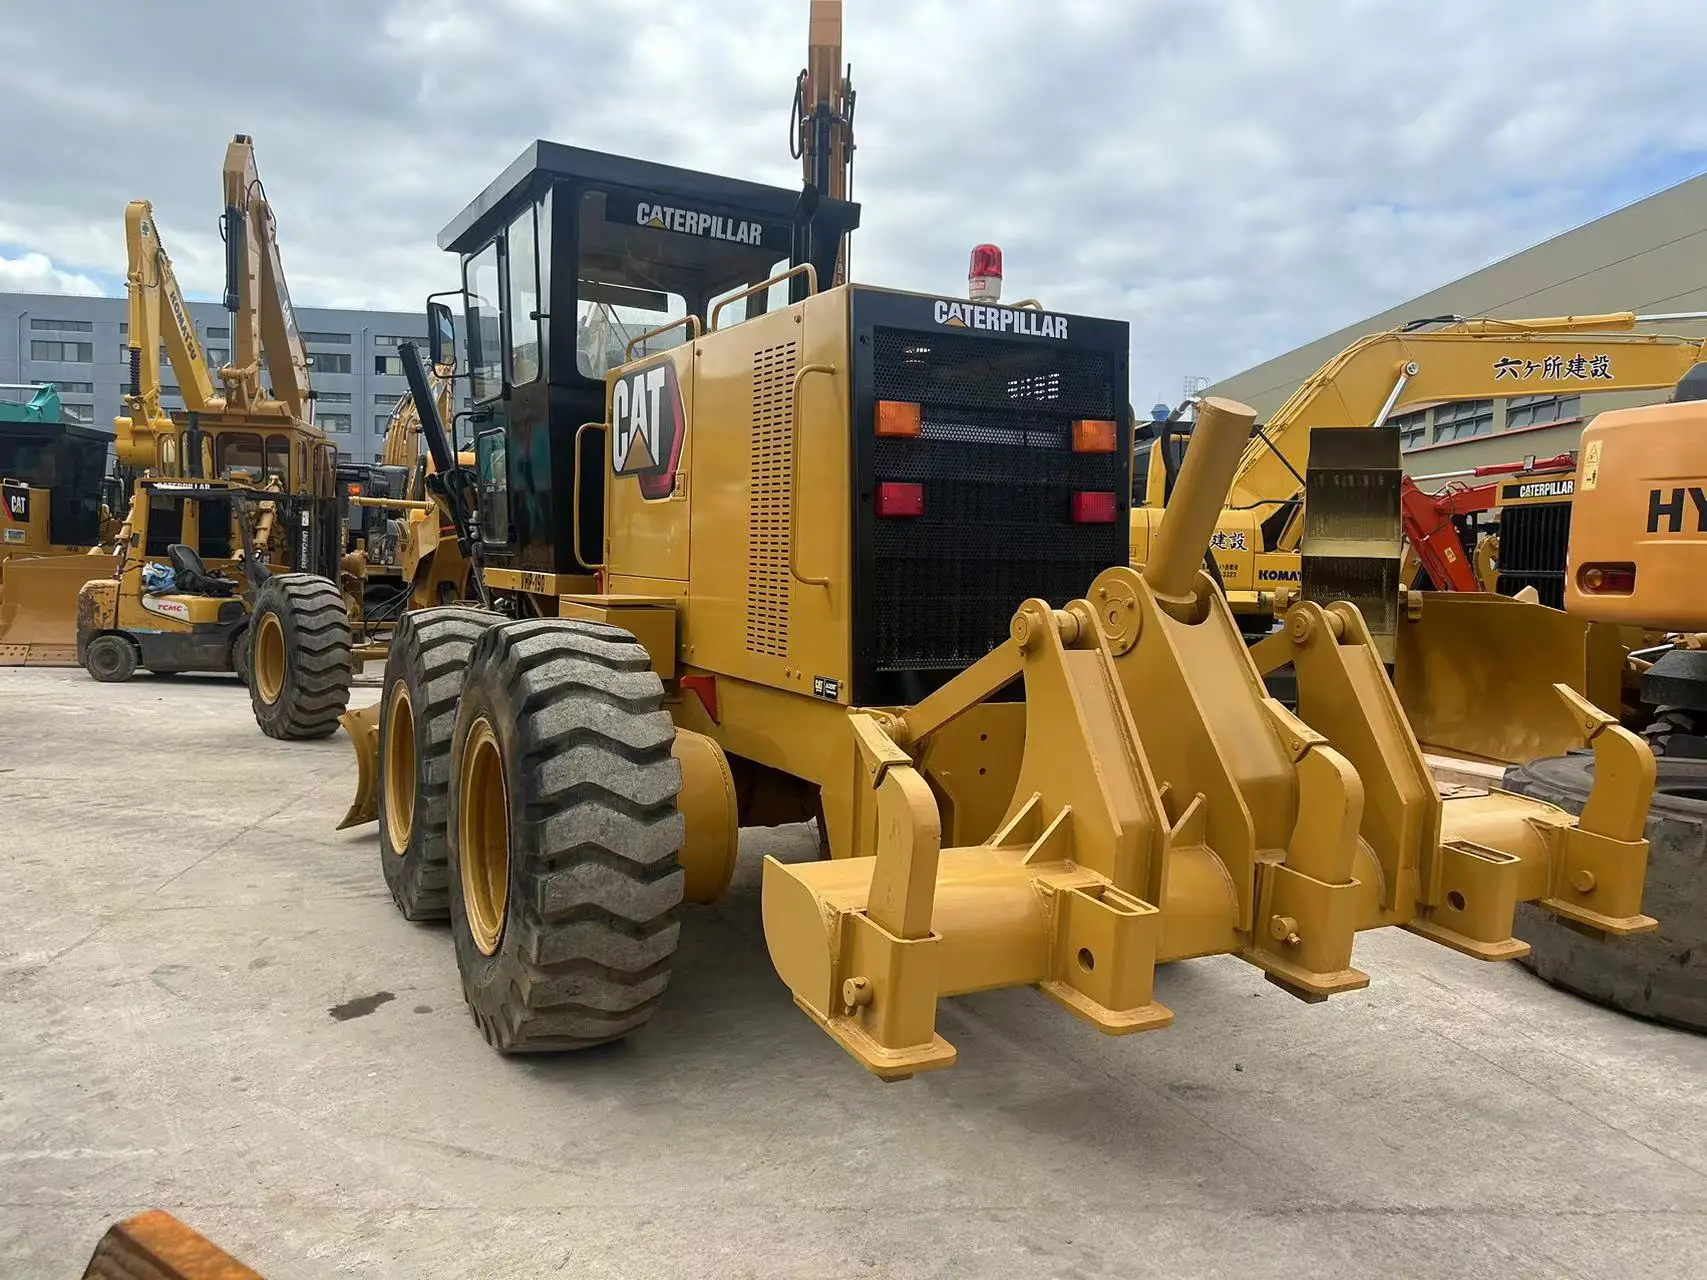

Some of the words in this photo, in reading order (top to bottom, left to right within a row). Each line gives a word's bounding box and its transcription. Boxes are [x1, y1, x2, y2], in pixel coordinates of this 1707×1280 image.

[637, 202, 762, 246] CATERPILLAR
[169, 290, 197, 361] KOMATSU
[934, 300, 1067, 340] CATERPILLAR
[612, 366, 665, 472] CAT
[11, 495, 26, 514] CAT
[1519, 480, 1574, 498] CATERPILLAR
